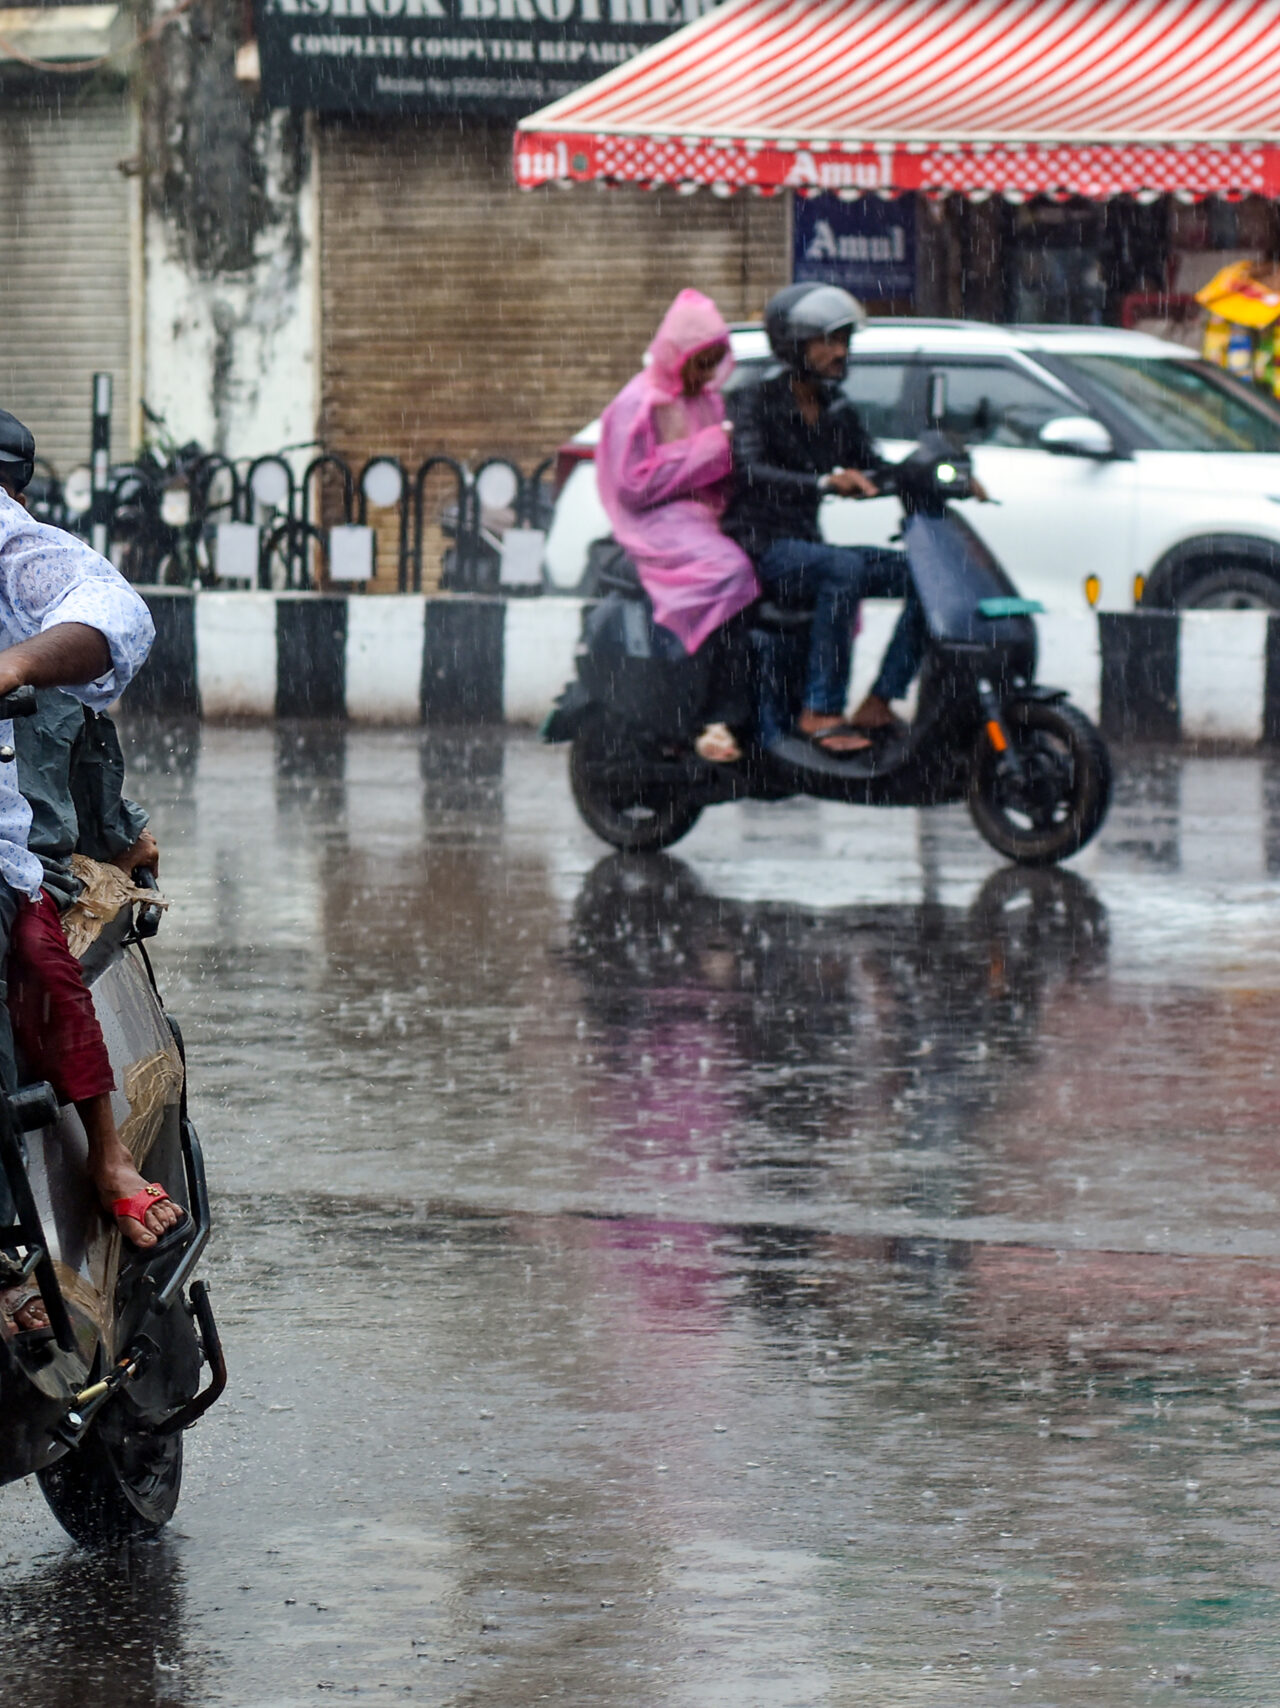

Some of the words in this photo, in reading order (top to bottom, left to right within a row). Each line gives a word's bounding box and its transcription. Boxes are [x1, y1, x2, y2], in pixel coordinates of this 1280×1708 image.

[290, 33, 406, 58] COMPLETE
[411, 36, 535, 63] COMPUTER
[538, 41, 650, 64] REPARIN
[783, 150, 893, 188] Amul
[804, 219, 905, 261] Amul
